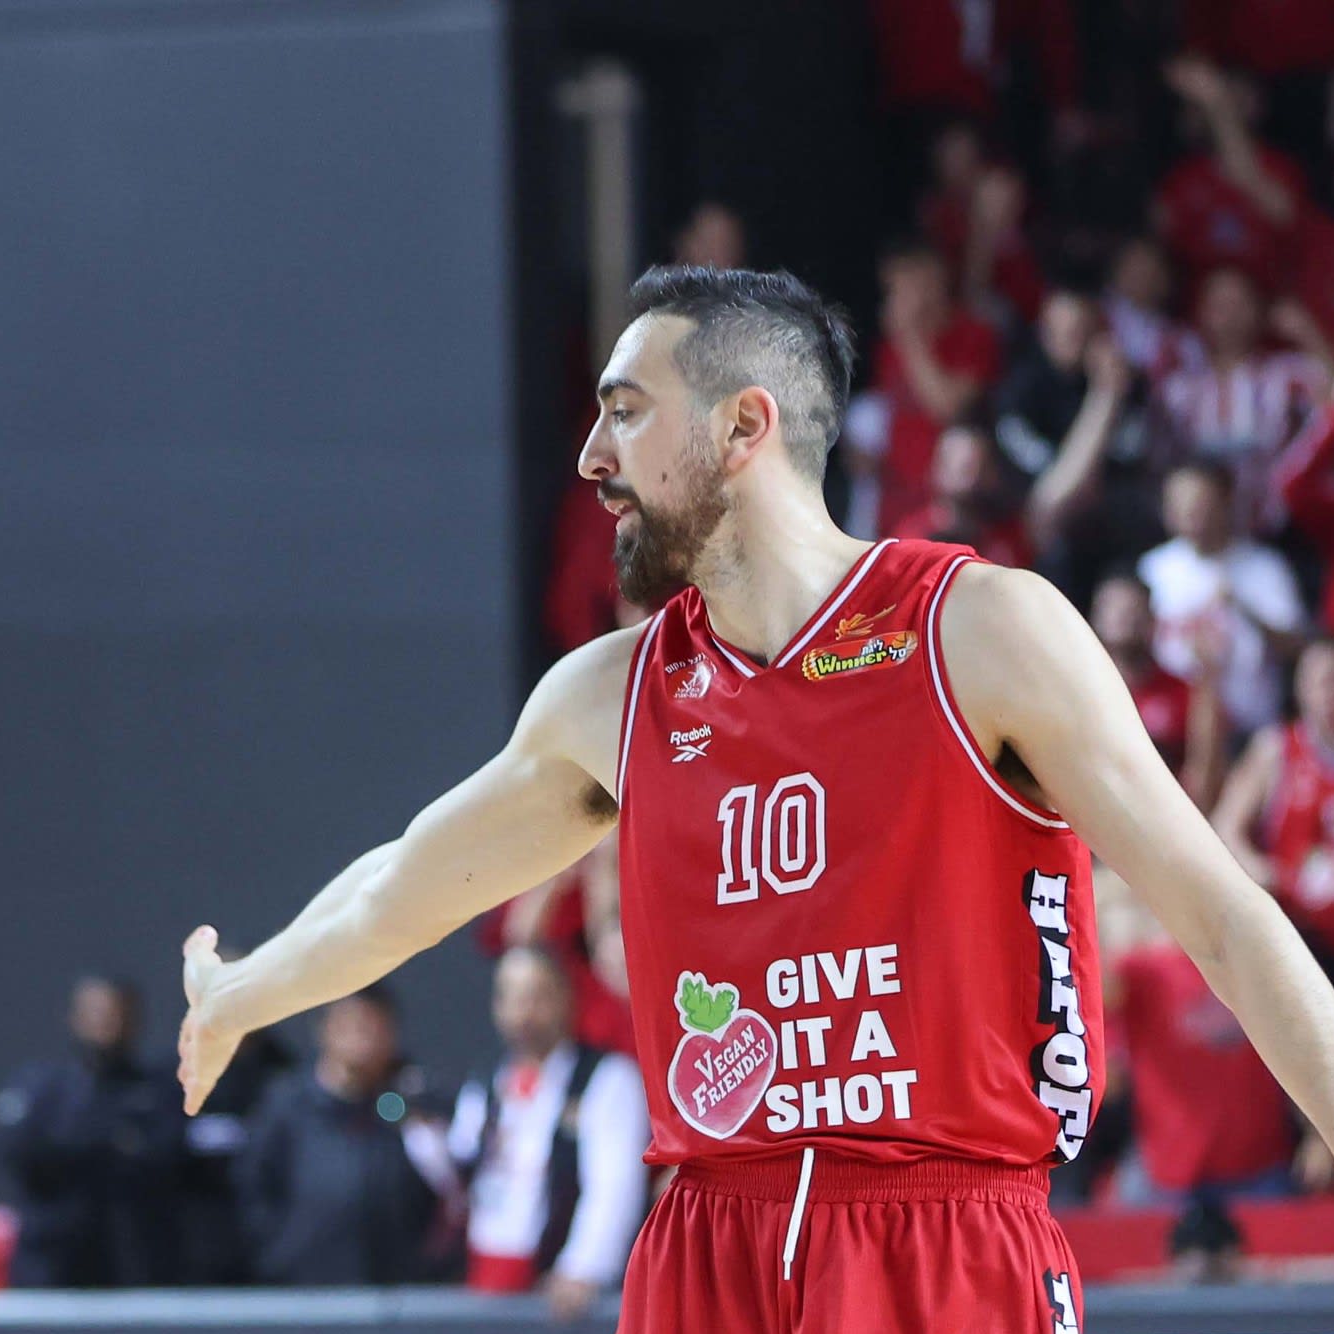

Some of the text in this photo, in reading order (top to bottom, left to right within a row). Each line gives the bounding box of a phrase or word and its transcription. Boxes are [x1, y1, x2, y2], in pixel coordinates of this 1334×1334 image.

[670, 723, 712, 745] Reebok
[717, 771, 827, 905] 10
[766, 943, 902, 1009] GIVE
[780, 1010, 898, 1070] IT A
[692, 1038, 769, 1118] FRIENDLY
[765, 1069, 918, 1133] SHOT
